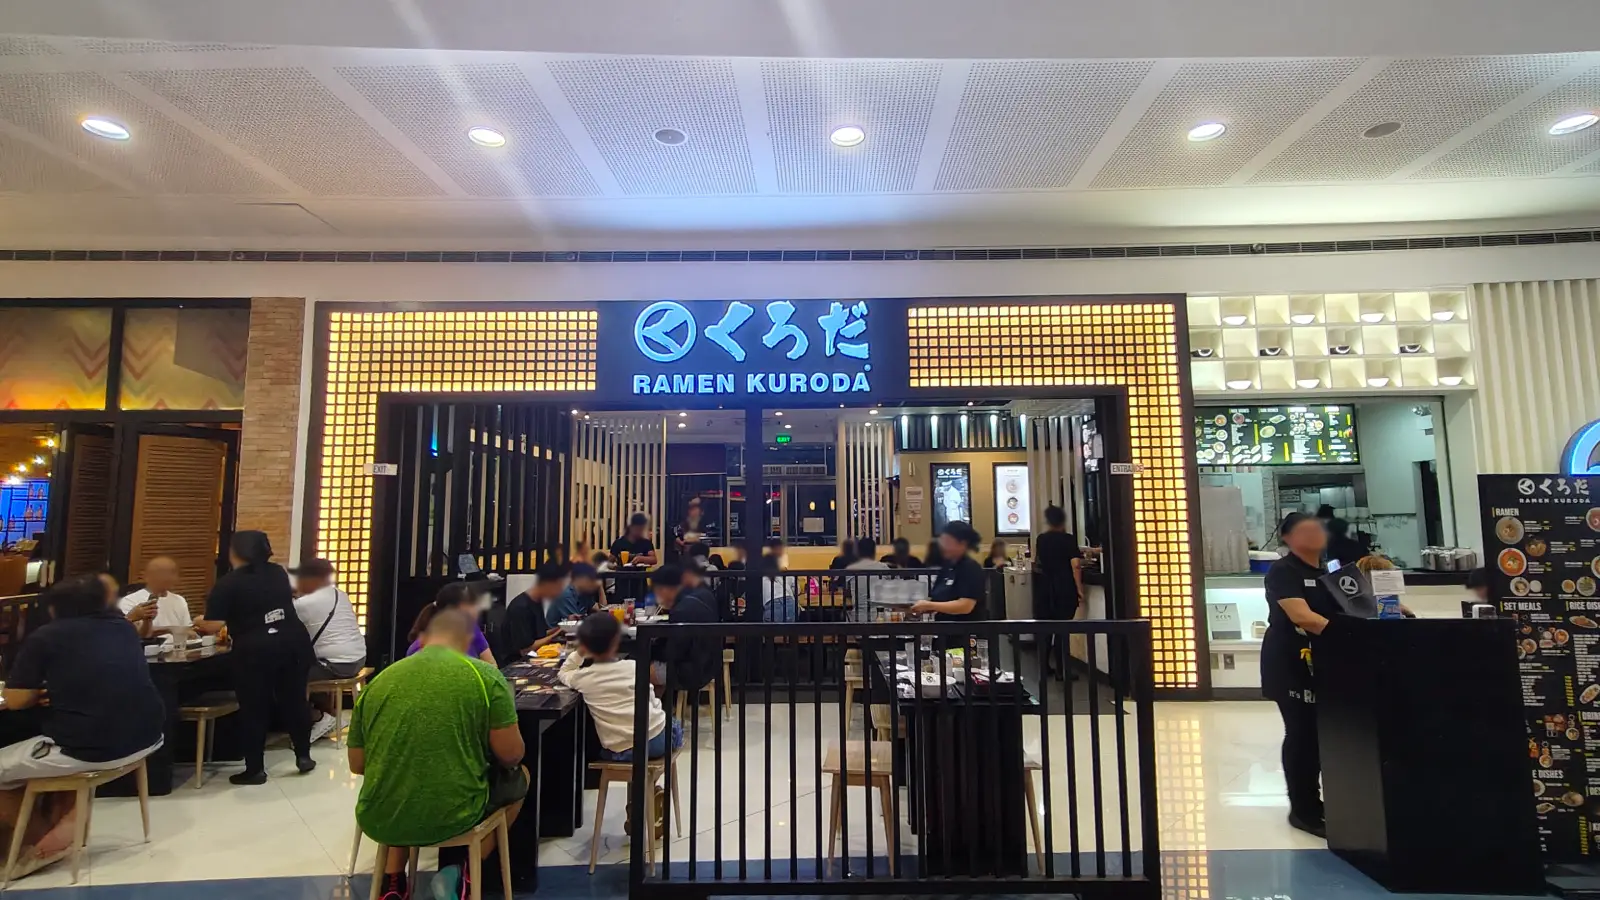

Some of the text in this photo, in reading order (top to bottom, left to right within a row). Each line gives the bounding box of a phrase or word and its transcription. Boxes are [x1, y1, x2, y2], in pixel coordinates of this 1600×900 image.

[704, 301, 869, 361] くろだ
[633, 372, 870, 393] RAMEN KURODA
[1112, 464, 1143, 473] ENTRANCE
[1539, 478, 1590, 495] くろだ
[1495, 507, 1519, 516] RAMEN
[1503, 602, 1542, 611] SET MEALS
